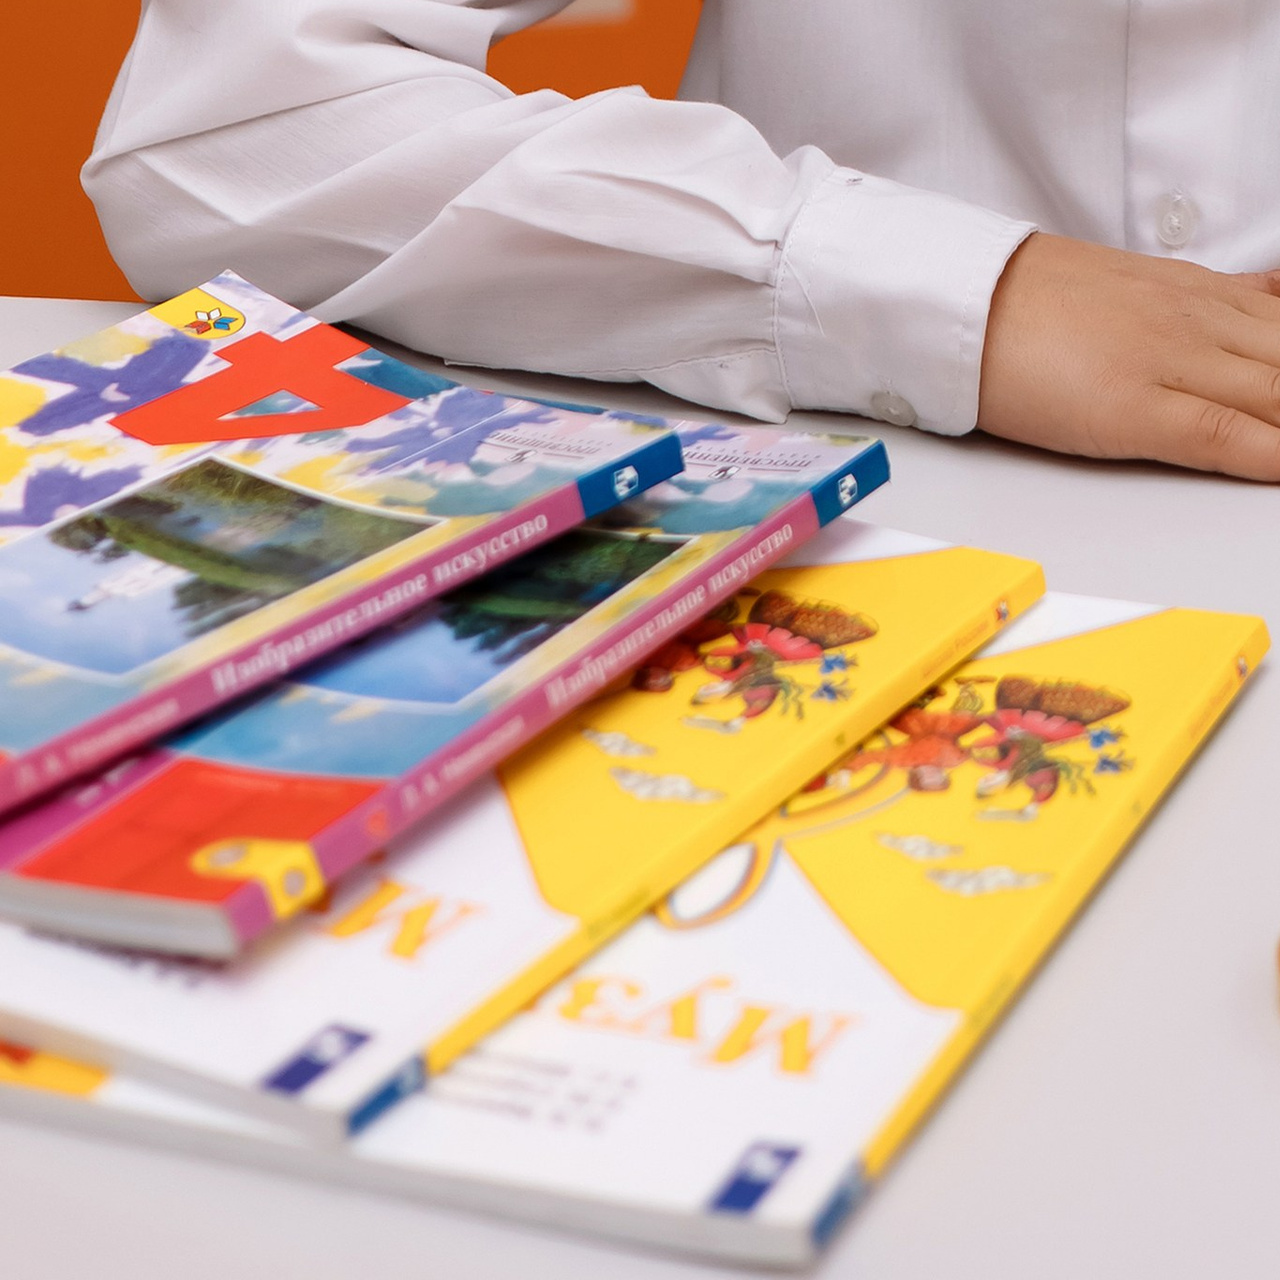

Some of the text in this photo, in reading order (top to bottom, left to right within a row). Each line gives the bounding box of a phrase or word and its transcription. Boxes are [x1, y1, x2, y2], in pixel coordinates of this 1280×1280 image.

[106, 321, 413, 447] 4
[683, 450, 813, 468] ПРОСВЕЩЕНИ
[210, 513, 549, 696] Изобразительное искусство
[544, 523, 793, 707] Изобразительное искусство
[527, 973, 858, 1076] Муз
